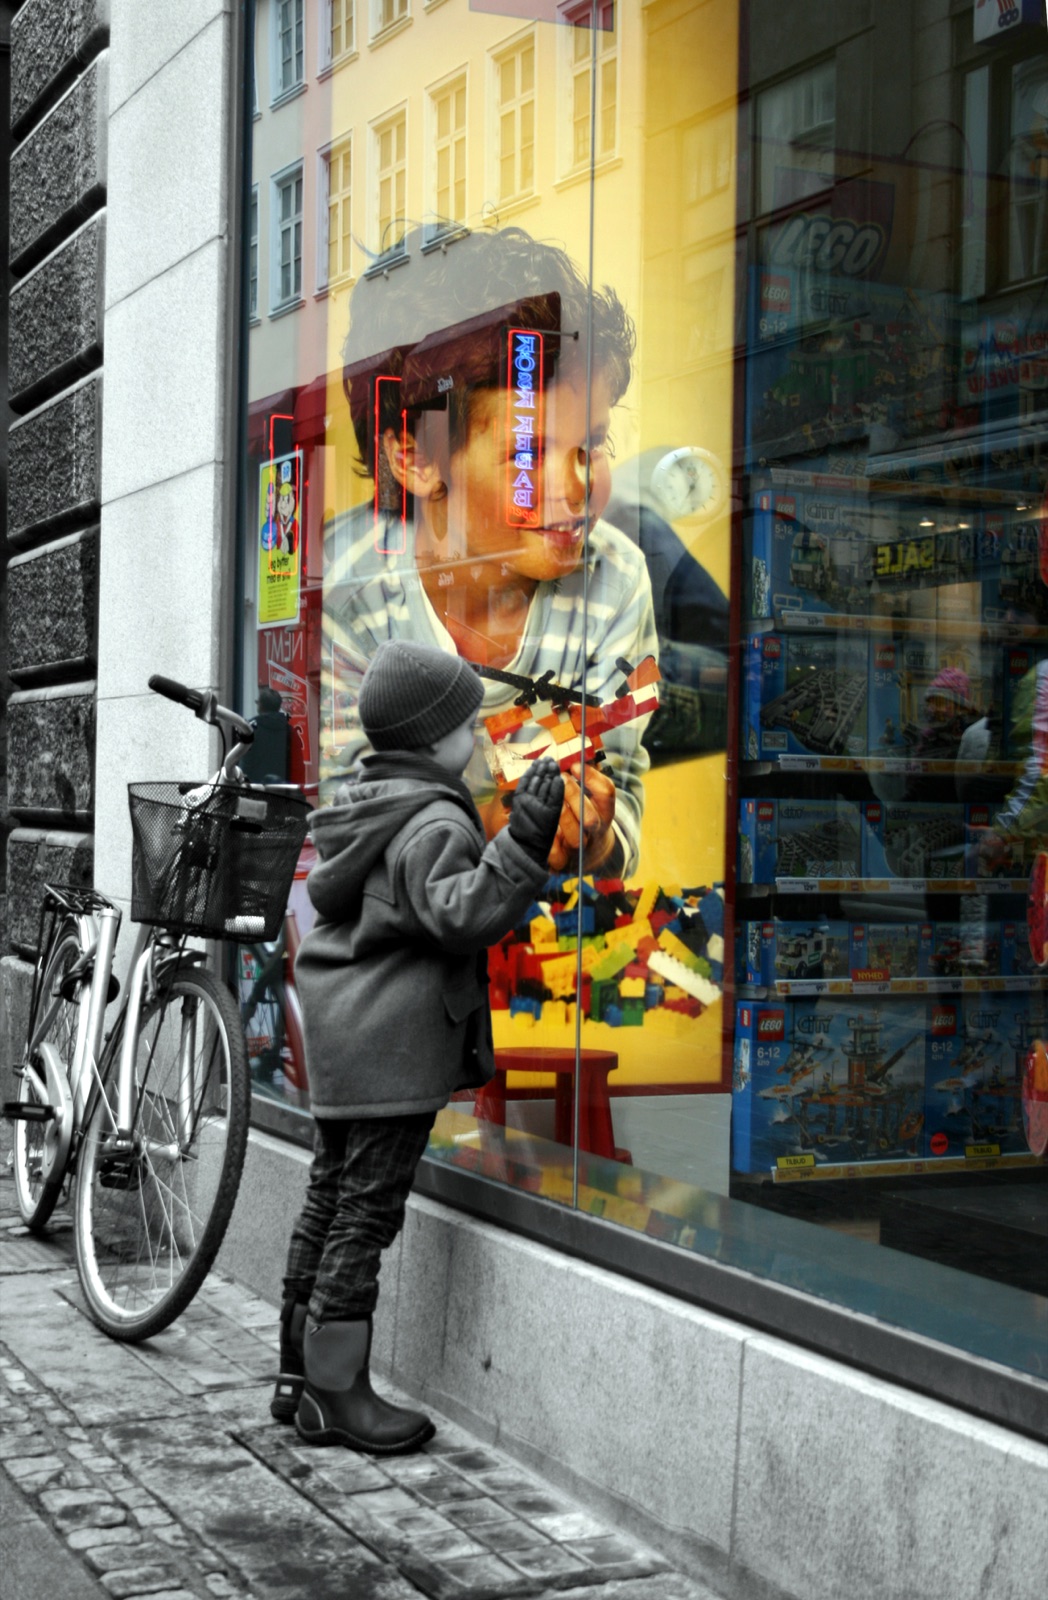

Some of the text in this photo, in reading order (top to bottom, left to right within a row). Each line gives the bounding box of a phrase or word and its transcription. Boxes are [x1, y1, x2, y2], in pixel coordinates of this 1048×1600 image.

[771, 214, 884, 277] LEGO
[762, 286, 789, 301] LEGO
[759, 318, 788, 334] 6-12
[776, 503, 794, 513] LEGO
[806, 503, 838, 520] CITY
[774, 524, 793, 535] 5-12
[764, 643, 781, 652] LEGO
[875, 651, 894, 660] LEGO
[762, 662, 779, 670] 5-12
[874, 671, 892, 681] 5-12
[857, 971, 884, 980] NYHED
[797, 1014, 834, 1034] CITY
[934, 1015, 954, 1026] LEGO
[969, 1009, 1002, 1028] CITY
[760, 1019, 783, 1031] LEGO
[757, 1046, 781, 1058] 6-12
[931, 1041, 953, 1052] 6-12
[973, 1146, 993, 1154] TILBUD
[785, 1157, 807, 1165] TILBUD
